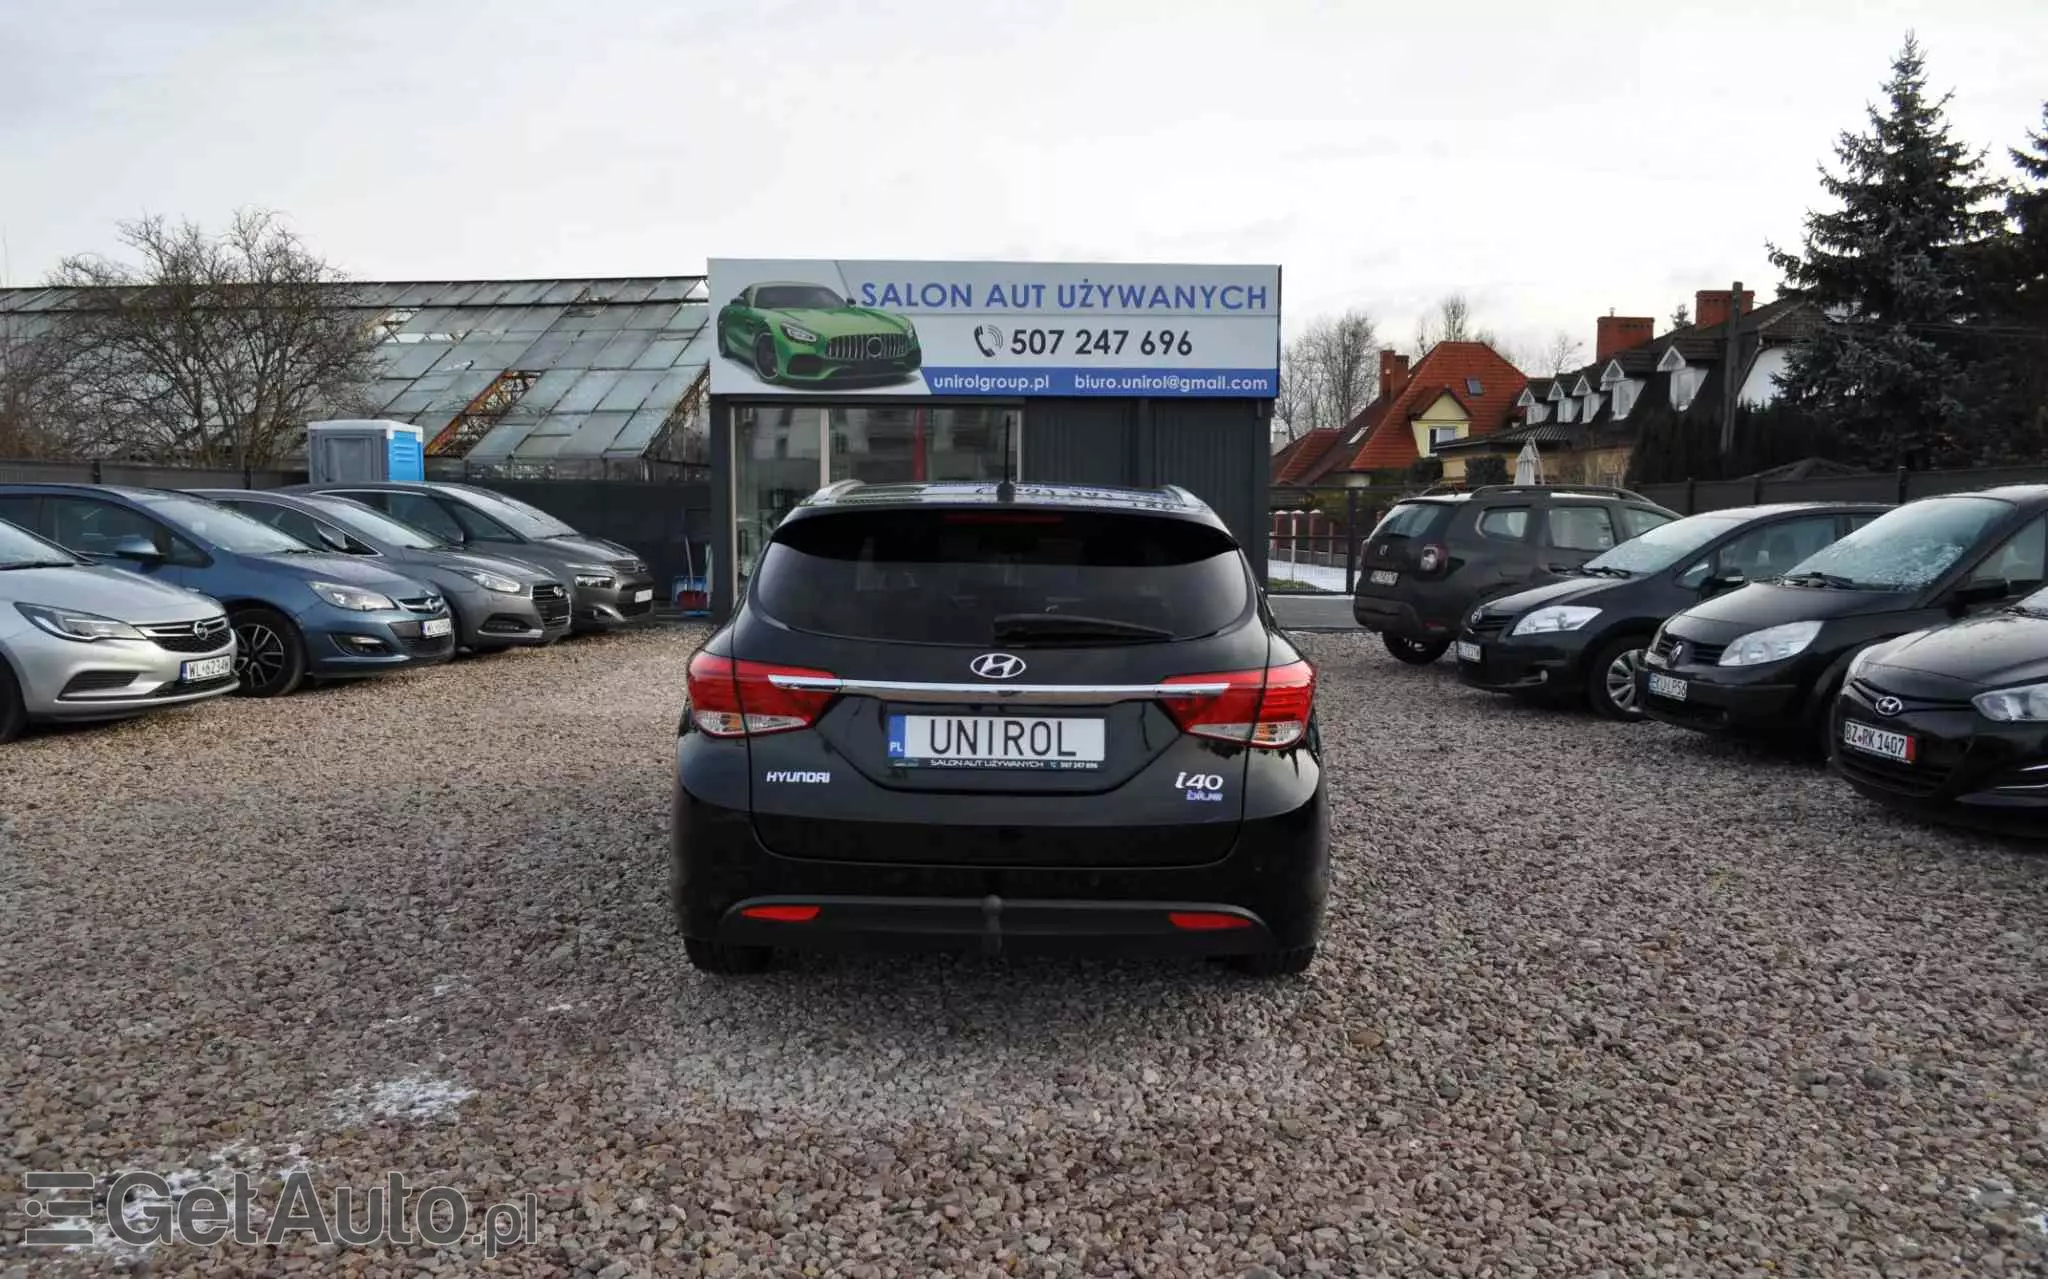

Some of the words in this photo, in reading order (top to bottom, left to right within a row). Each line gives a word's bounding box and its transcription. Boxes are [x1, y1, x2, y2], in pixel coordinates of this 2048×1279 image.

[861, 282, 973, 308] SALON
[985, 283, 1046, 309] AUT
[1058, 278, 1266, 310] UŻYWANYCH
[1011, 329, 1065, 356] 507
[1075, 329, 1130, 356] 247
[1140, 330, 1193, 356] 696
[934, 374, 1050, 391] unirolgroup.pl
[1074, 375, 1269, 393] biuro.unirol@gmail.com
[929, 718, 1077, 757] UNIROL
[930, 759, 962, 767] SALON
[963, 760, 982, 768] AUT
[766, 771, 831, 783] HYUNDAI
[1175, 771, 1223, 790] i40
